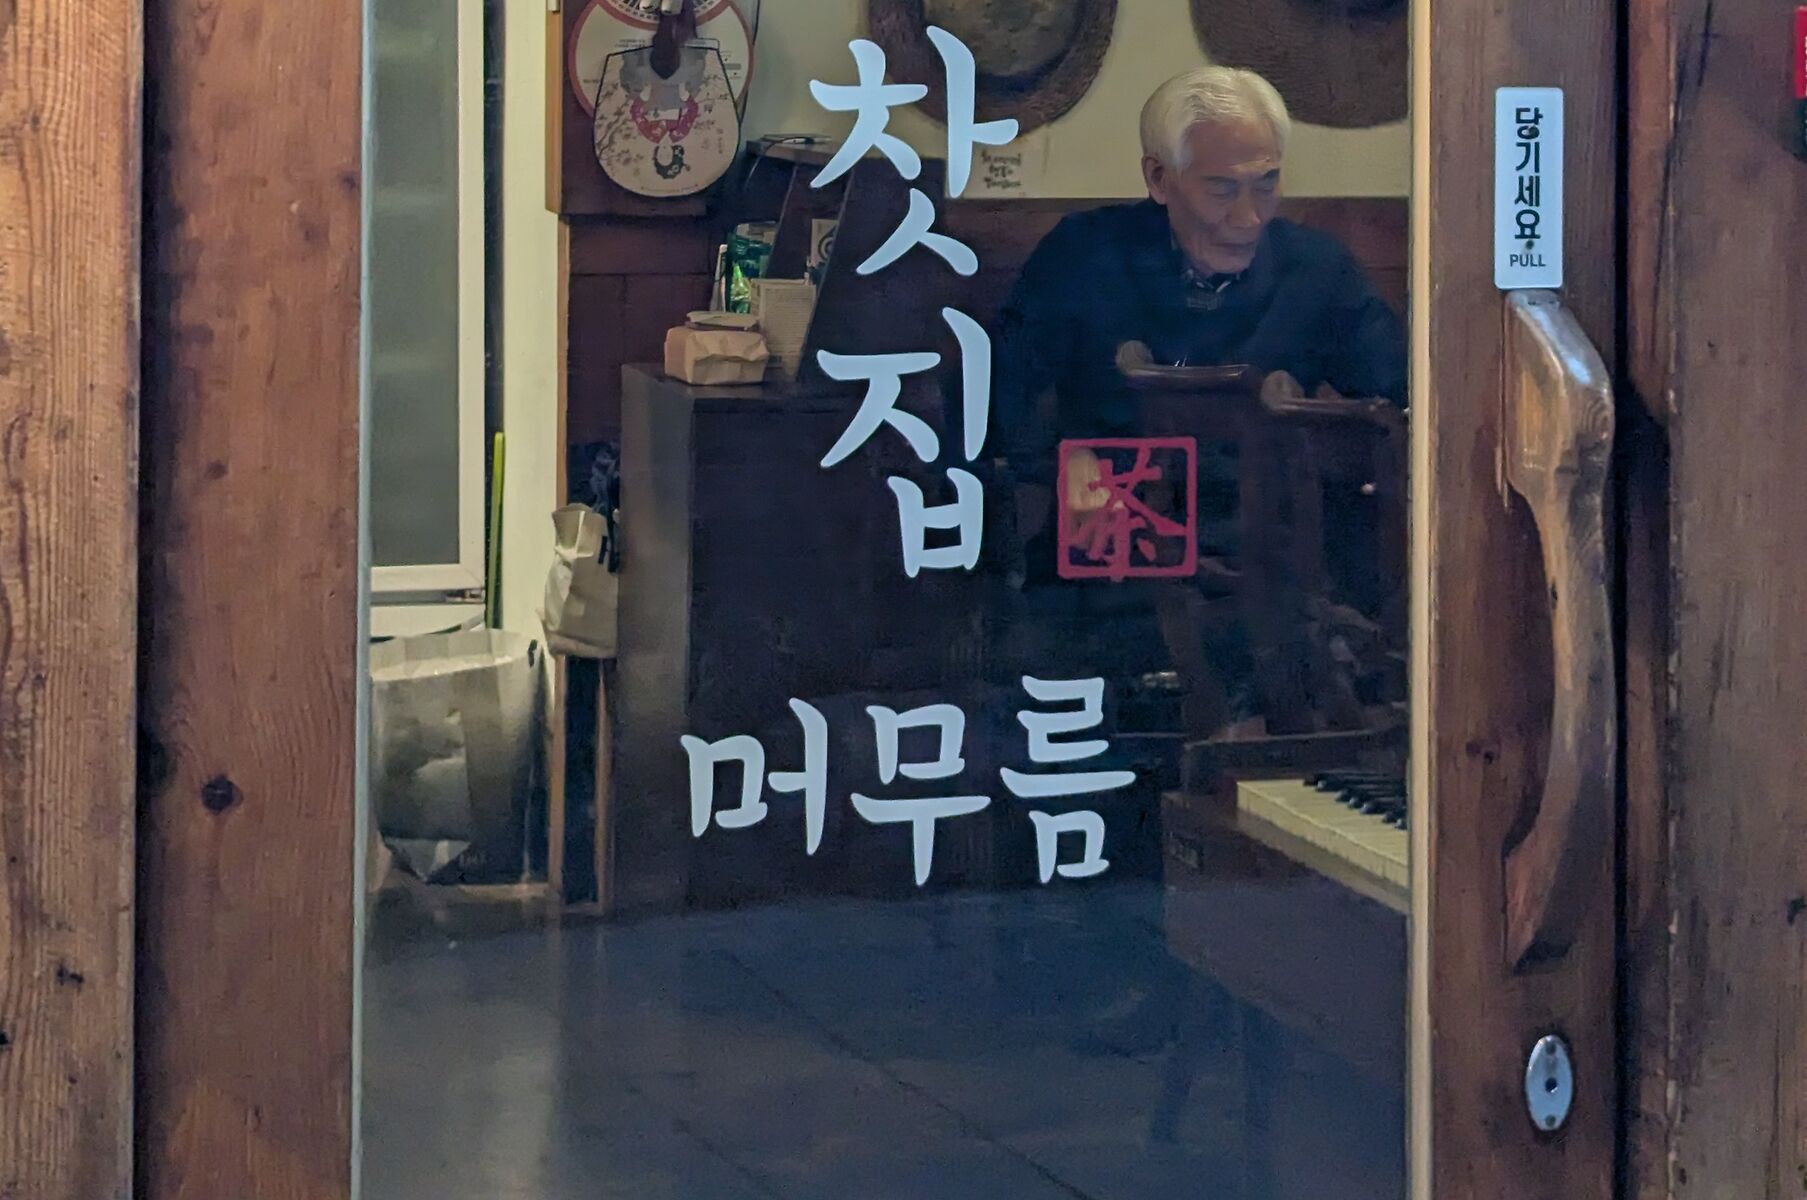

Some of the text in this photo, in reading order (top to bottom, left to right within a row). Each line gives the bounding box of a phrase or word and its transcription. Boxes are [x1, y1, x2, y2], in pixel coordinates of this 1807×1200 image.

[1514, 107, 1544, 240] 당기세요
[1509, 254, 1547, 268] PULL
[680, 675, 1136, 888] 머무름
